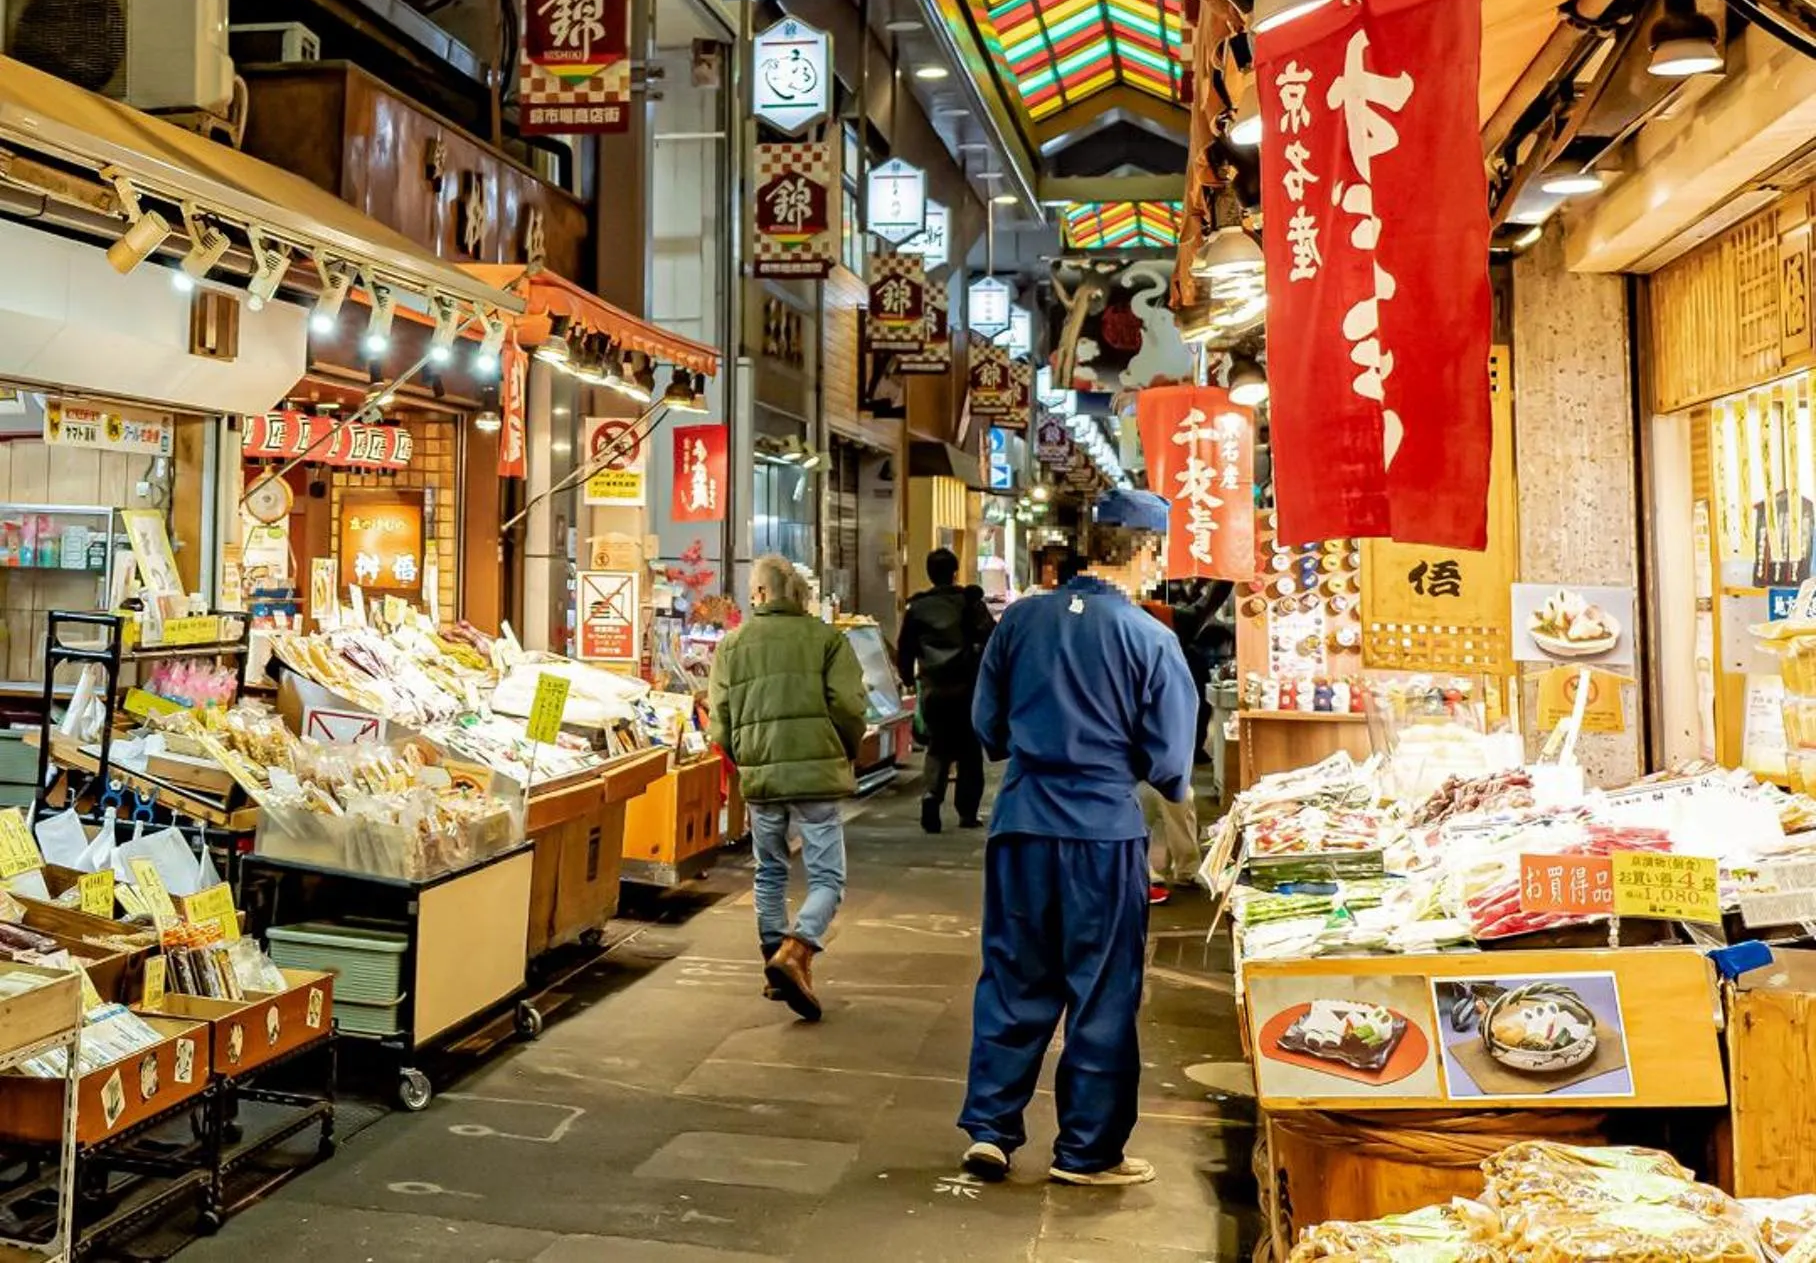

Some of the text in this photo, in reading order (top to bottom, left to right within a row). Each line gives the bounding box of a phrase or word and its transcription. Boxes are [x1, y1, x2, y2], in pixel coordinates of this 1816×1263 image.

[765, 179, 812, 232] 錦
[1526, 866, 1613, 904] お買得品
